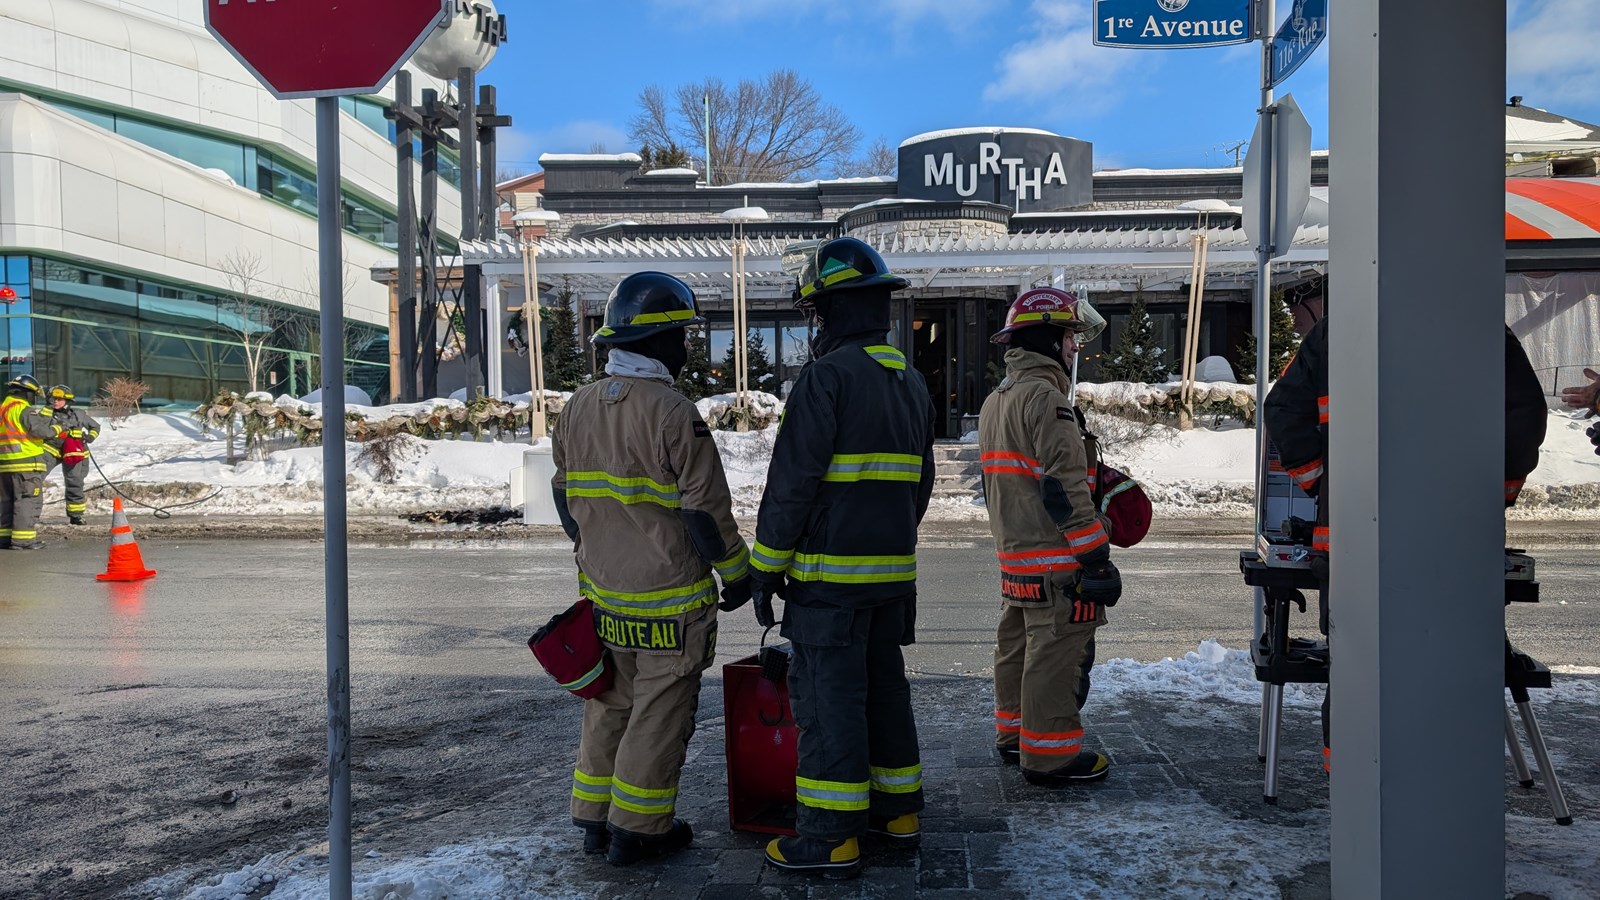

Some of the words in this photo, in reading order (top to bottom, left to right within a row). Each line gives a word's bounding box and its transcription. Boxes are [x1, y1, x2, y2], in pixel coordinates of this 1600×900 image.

[1103, 16, 1133, 38] 1re
[1140, 15, 1243, 38] Avenue
[1279, 38, 1296, 73] 116e
[1298, 21, 1318, 54] Rue
[924, 142, 1068, 200] MURTHA
[1024, 294, 1061, 305] LIEUTENANT
[597, 614, 677, 649] J.BUTEAU
